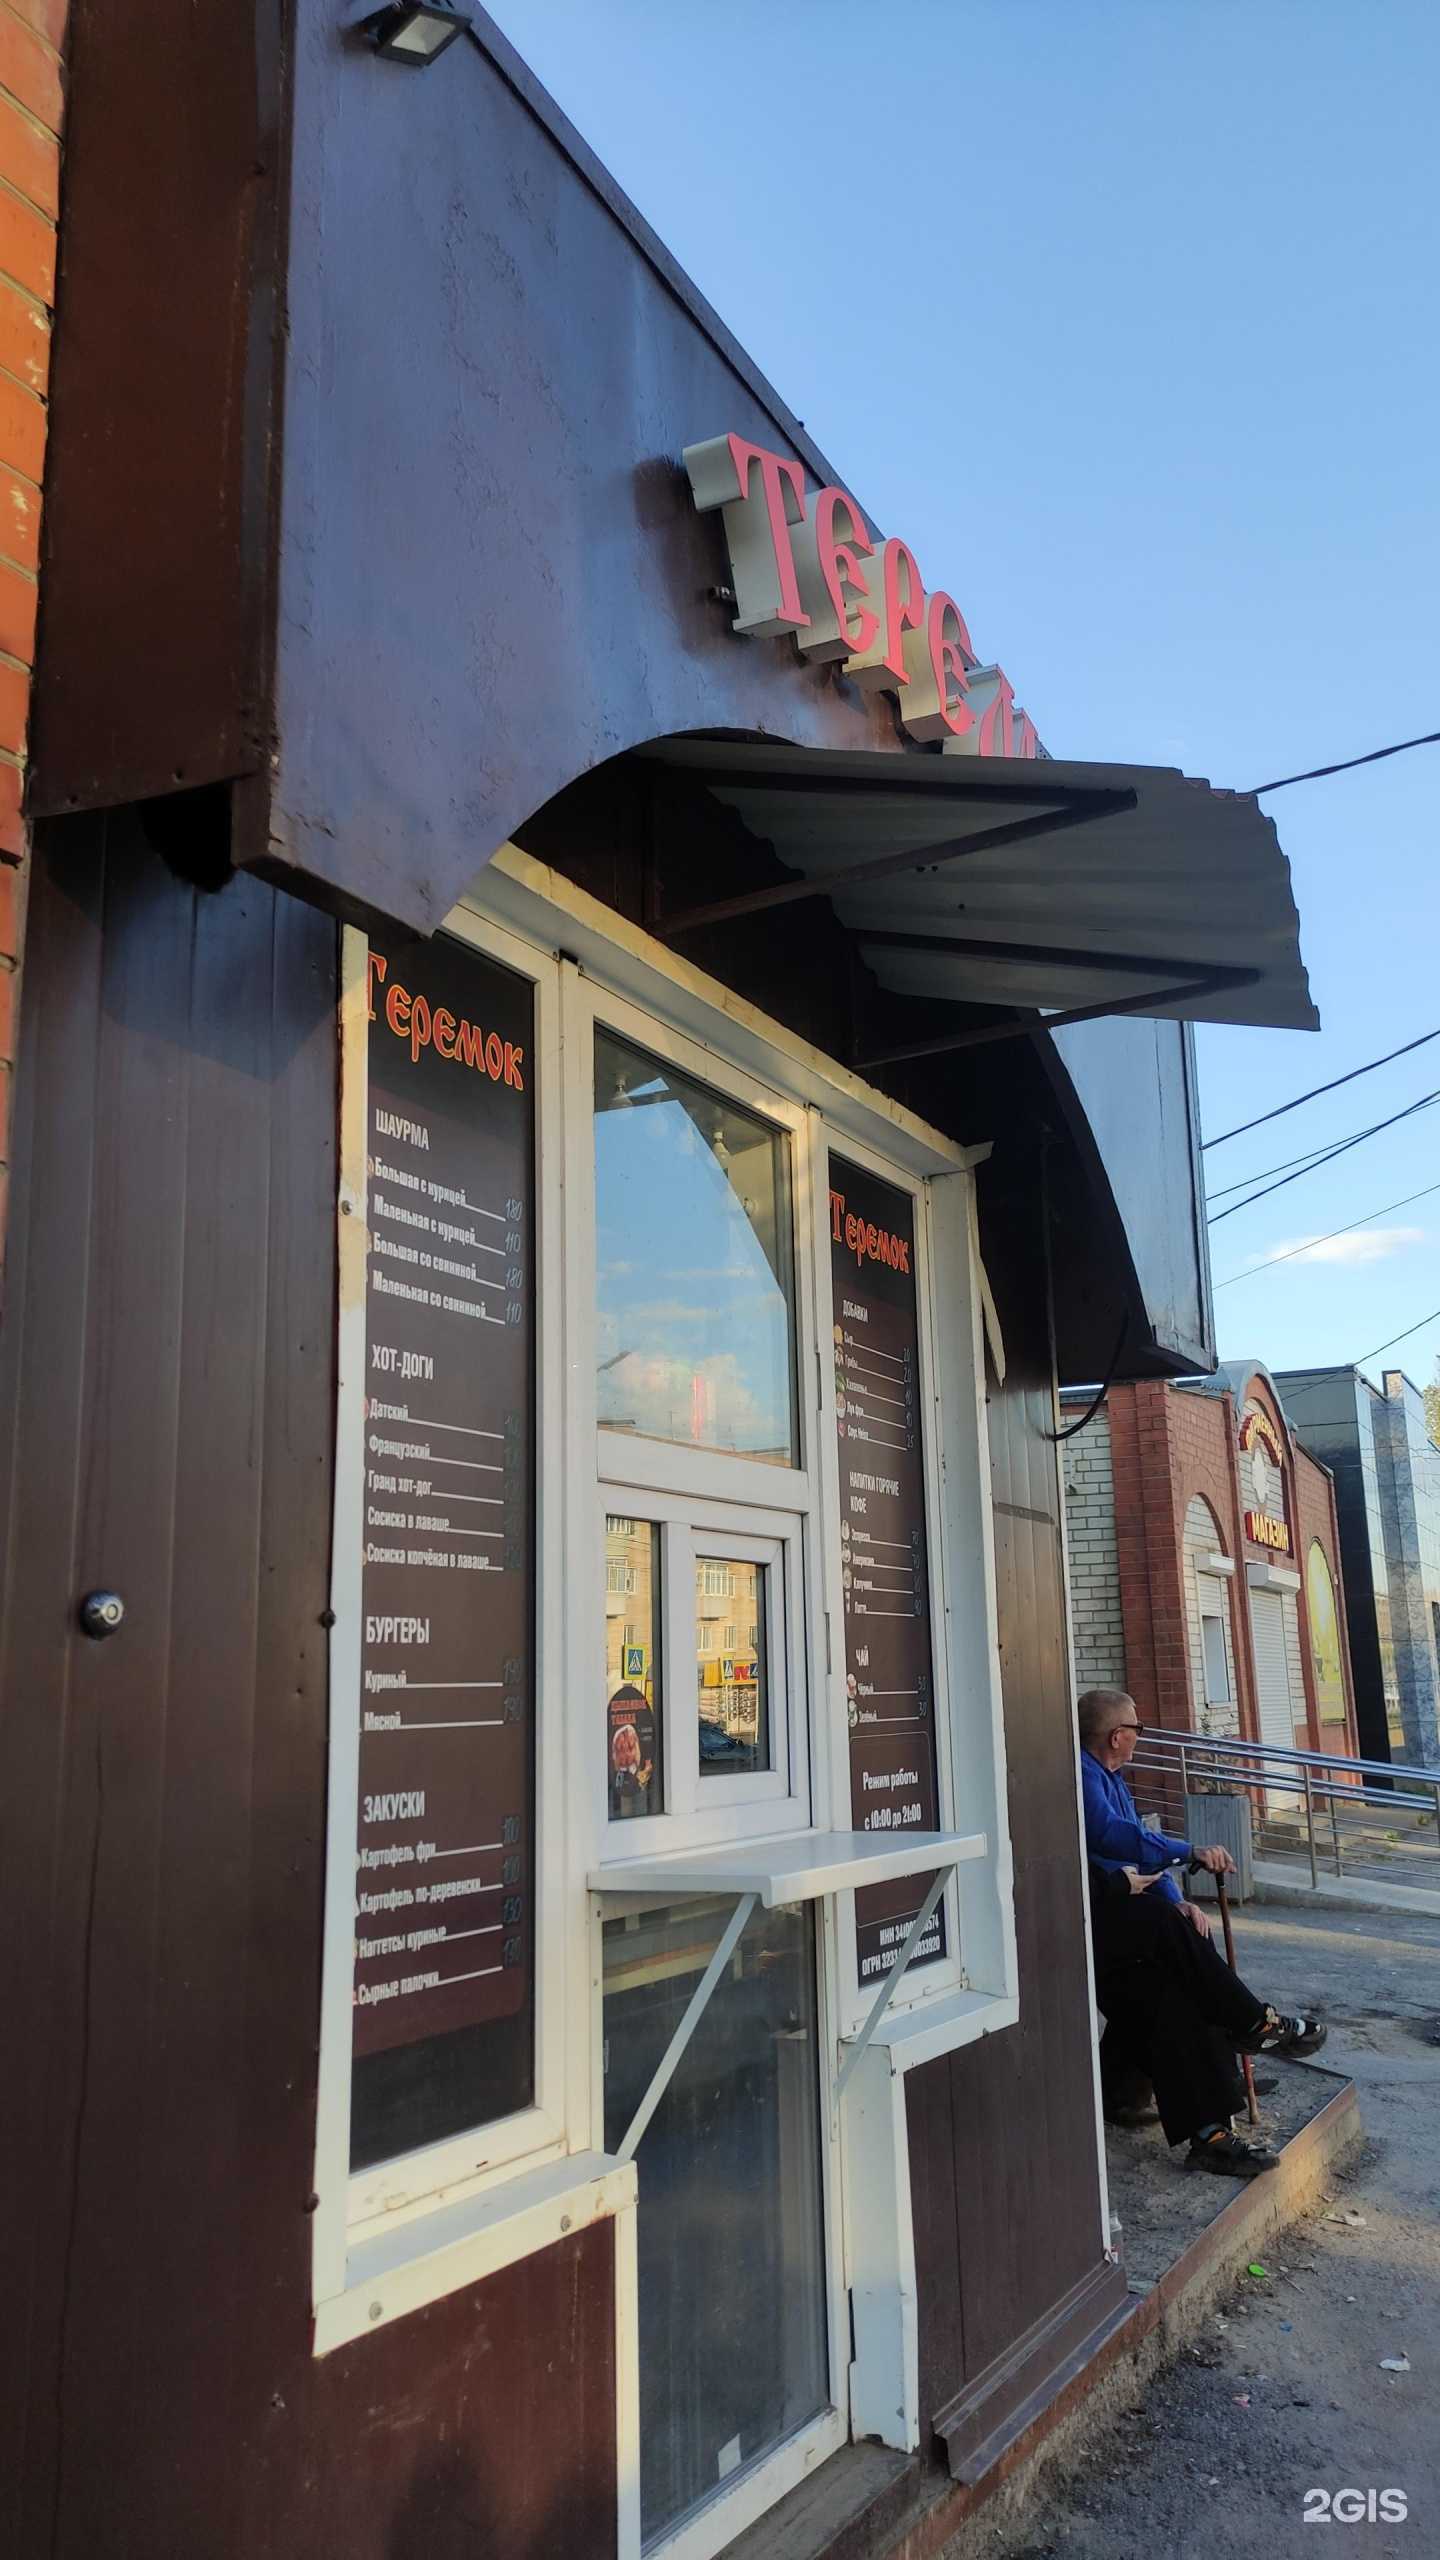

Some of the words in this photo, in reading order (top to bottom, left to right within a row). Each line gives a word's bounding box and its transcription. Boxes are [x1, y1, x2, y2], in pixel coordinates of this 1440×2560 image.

[375, 1108, 430, 1150] ШАУРМА
[375, 1156, 420, 1191] Большая
[421, 1179, 427, 1193] с
[428, 1183, 466, 1207] курицей
[374, 1194, 429, 1231] Маленькая
[431, 1219, 437, 1233] с
[438, 1221, 476, 1246] курицей
[829, 1190, 910, 1274] Теремок
[373, 1231, 419, 1267] Большая
[420, 1252, 432, 1267] со
[433, 1257, 477, 1281] свининой
[373, 1270, 429, 1304] Маленькая
[430, 1292, 442, 1308] со
[443, 1297, 487, 1320] свининой
[372, 1344, 434, 1380] ХОТ-ДОГИ
[368, 1470, 396, 1494] Гранд
[368, 1506, 406, 1528] Сосиска
[407, 1514, 414, 1529] в
[850, 1495, 867, 1514] КОФЕ
[1251, 1511, 1289, 1551] МАГАЗИН
[367, 1542, 406, 1564] Сосиска
[449, 1553, 456, 1568] в
[366, 1616, 430, 1644] БУРГЕРЫ
[855, 1645, 869, 1667] ЧАЙ
[863, 1771, 890, 1791] Режим
[890, 1768, 919, 1792] работы
[363, 1790, 425, 1823] ЗАКУСКИ
[864, 1817, 870, 1831] с
[870, 1807, 892, 1829] 10:00
[892, 1811, 902, 1829] до
[902, 1803, 922, 1824] 21:00
[360, 1844, 415, 1870] Картофель
[360, 1888, 414, 1916] Картофель
[862, 1954, 881, 1976] ОГРН
